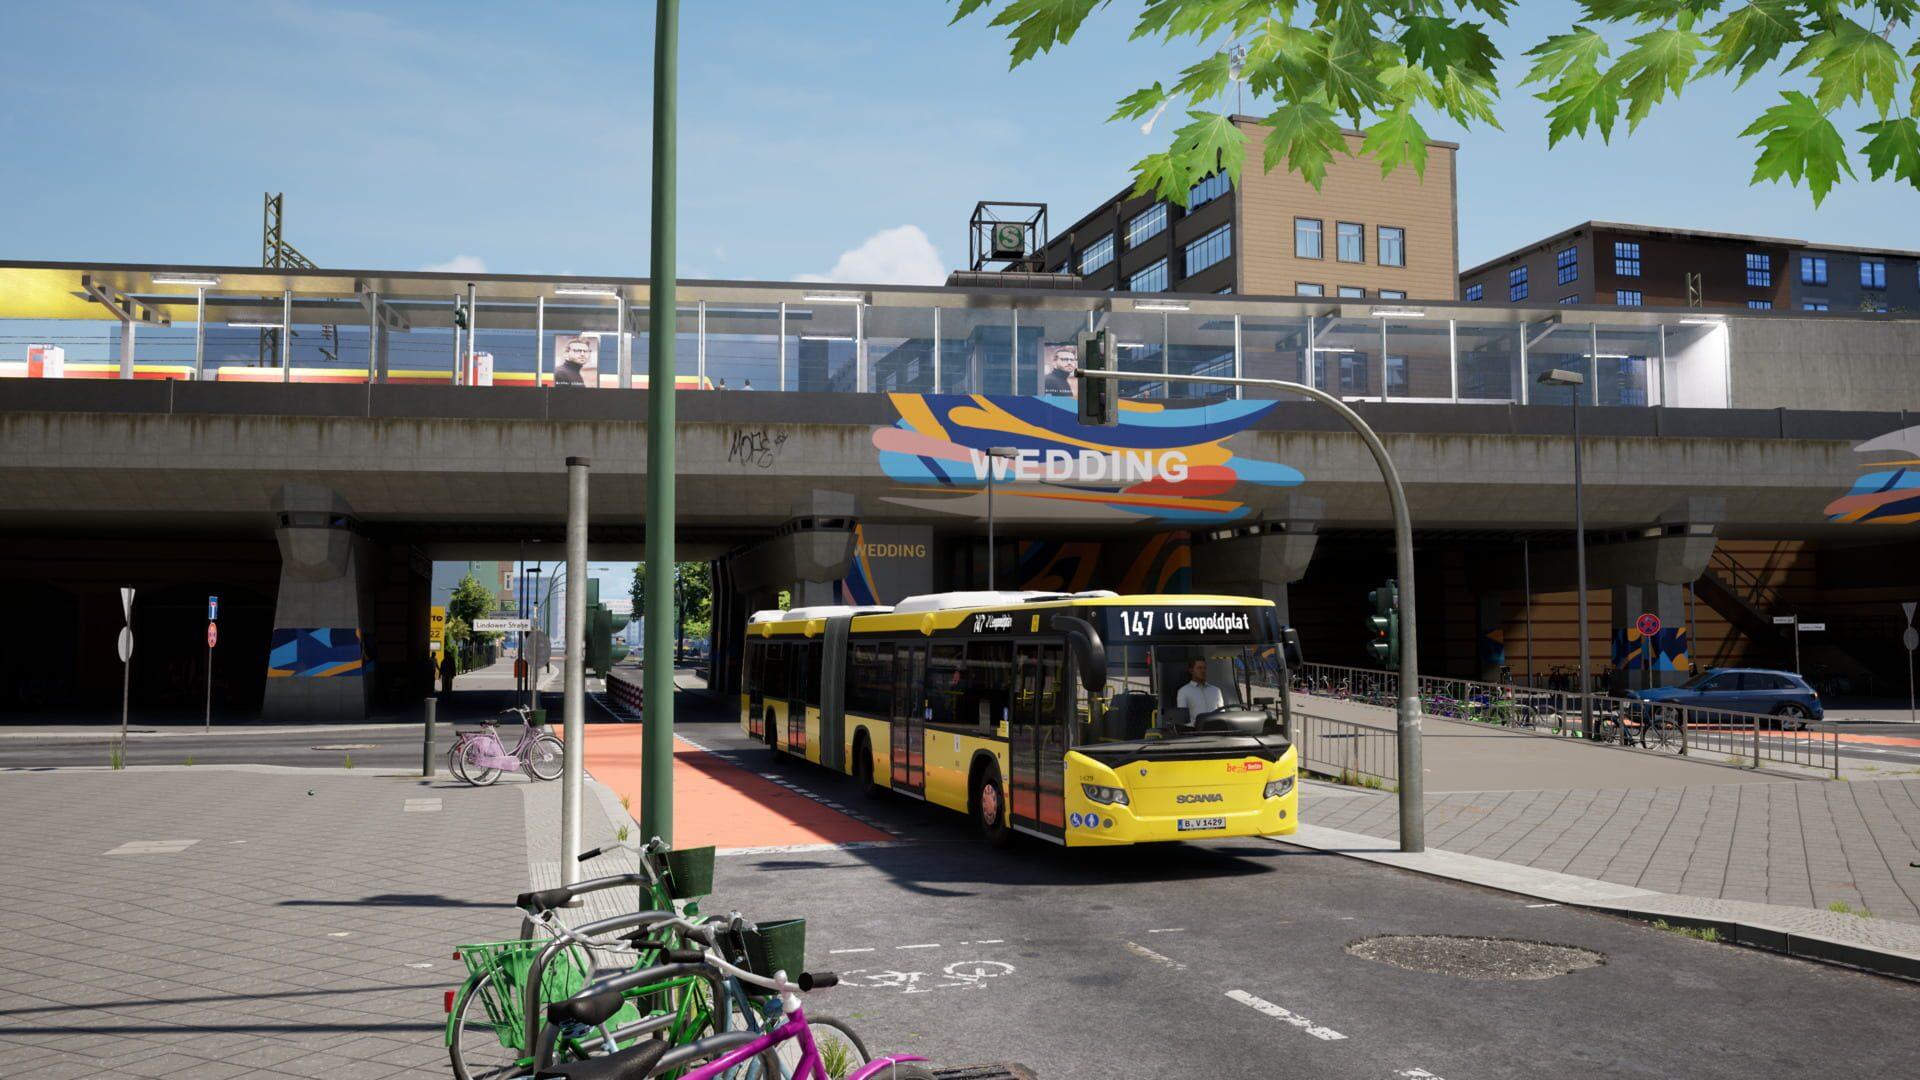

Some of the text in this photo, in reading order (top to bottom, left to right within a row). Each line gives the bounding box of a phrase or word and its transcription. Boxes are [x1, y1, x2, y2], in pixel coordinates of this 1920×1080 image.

[969, 449, 1189, 483] WEDDING
[854, 543, 927, 558] WEDDING
[476, 621, 506, 629] Lindower
[1120, 610, 1250, 636] 147 U Leopoldplat
[1176, 793, 1224, 804] SCANIA
